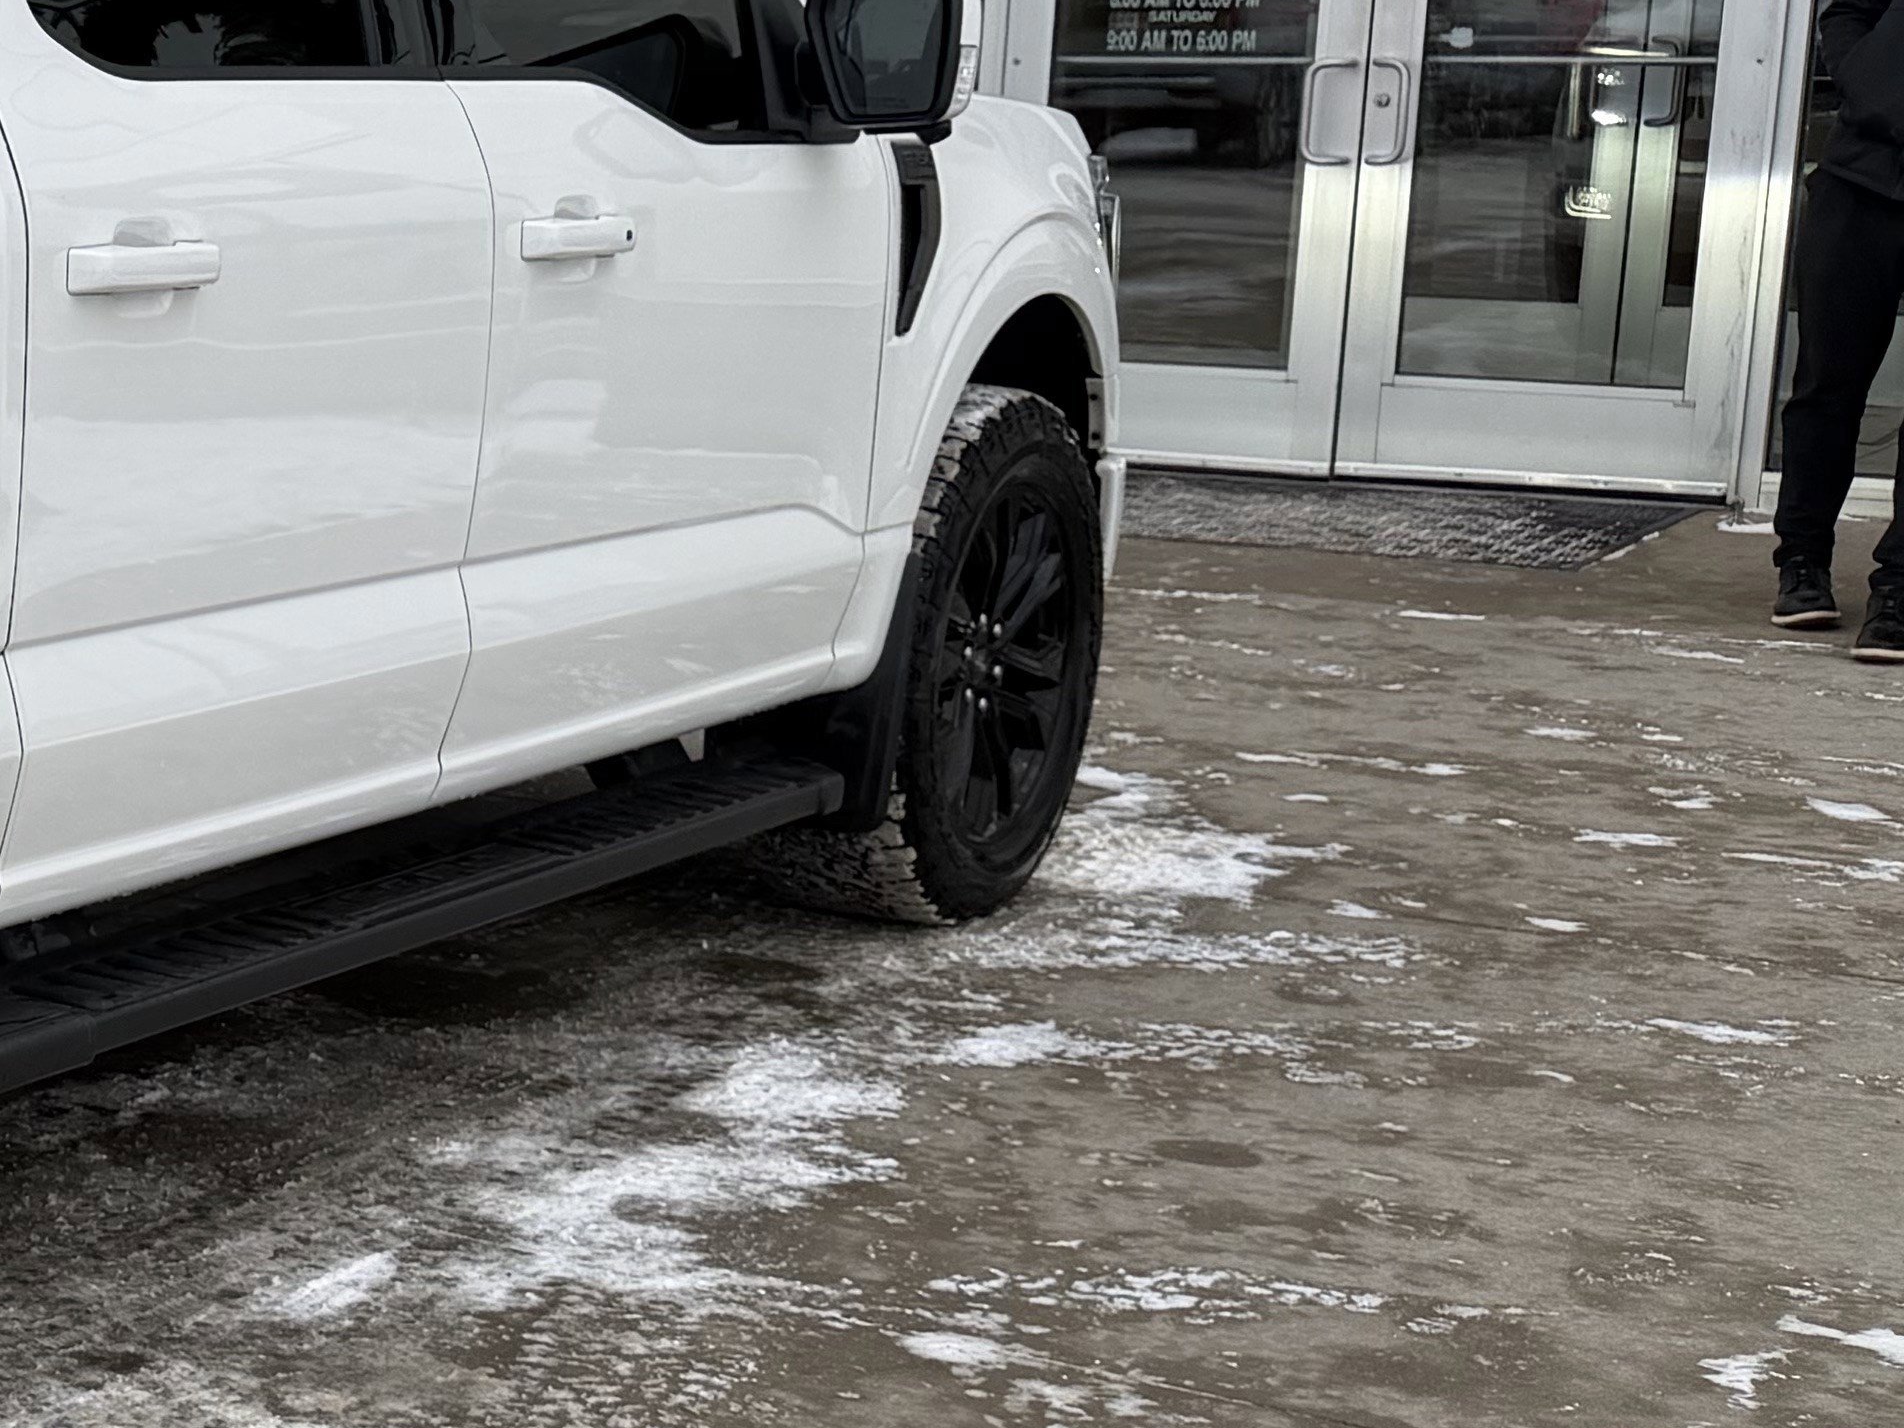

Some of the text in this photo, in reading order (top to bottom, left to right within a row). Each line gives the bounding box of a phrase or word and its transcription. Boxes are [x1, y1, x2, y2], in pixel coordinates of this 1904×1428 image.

[1147, 10, 1217, 23] SATURDAY
[1106, 30, 1256, 52] 9:00 AM TO 6:00 PM
